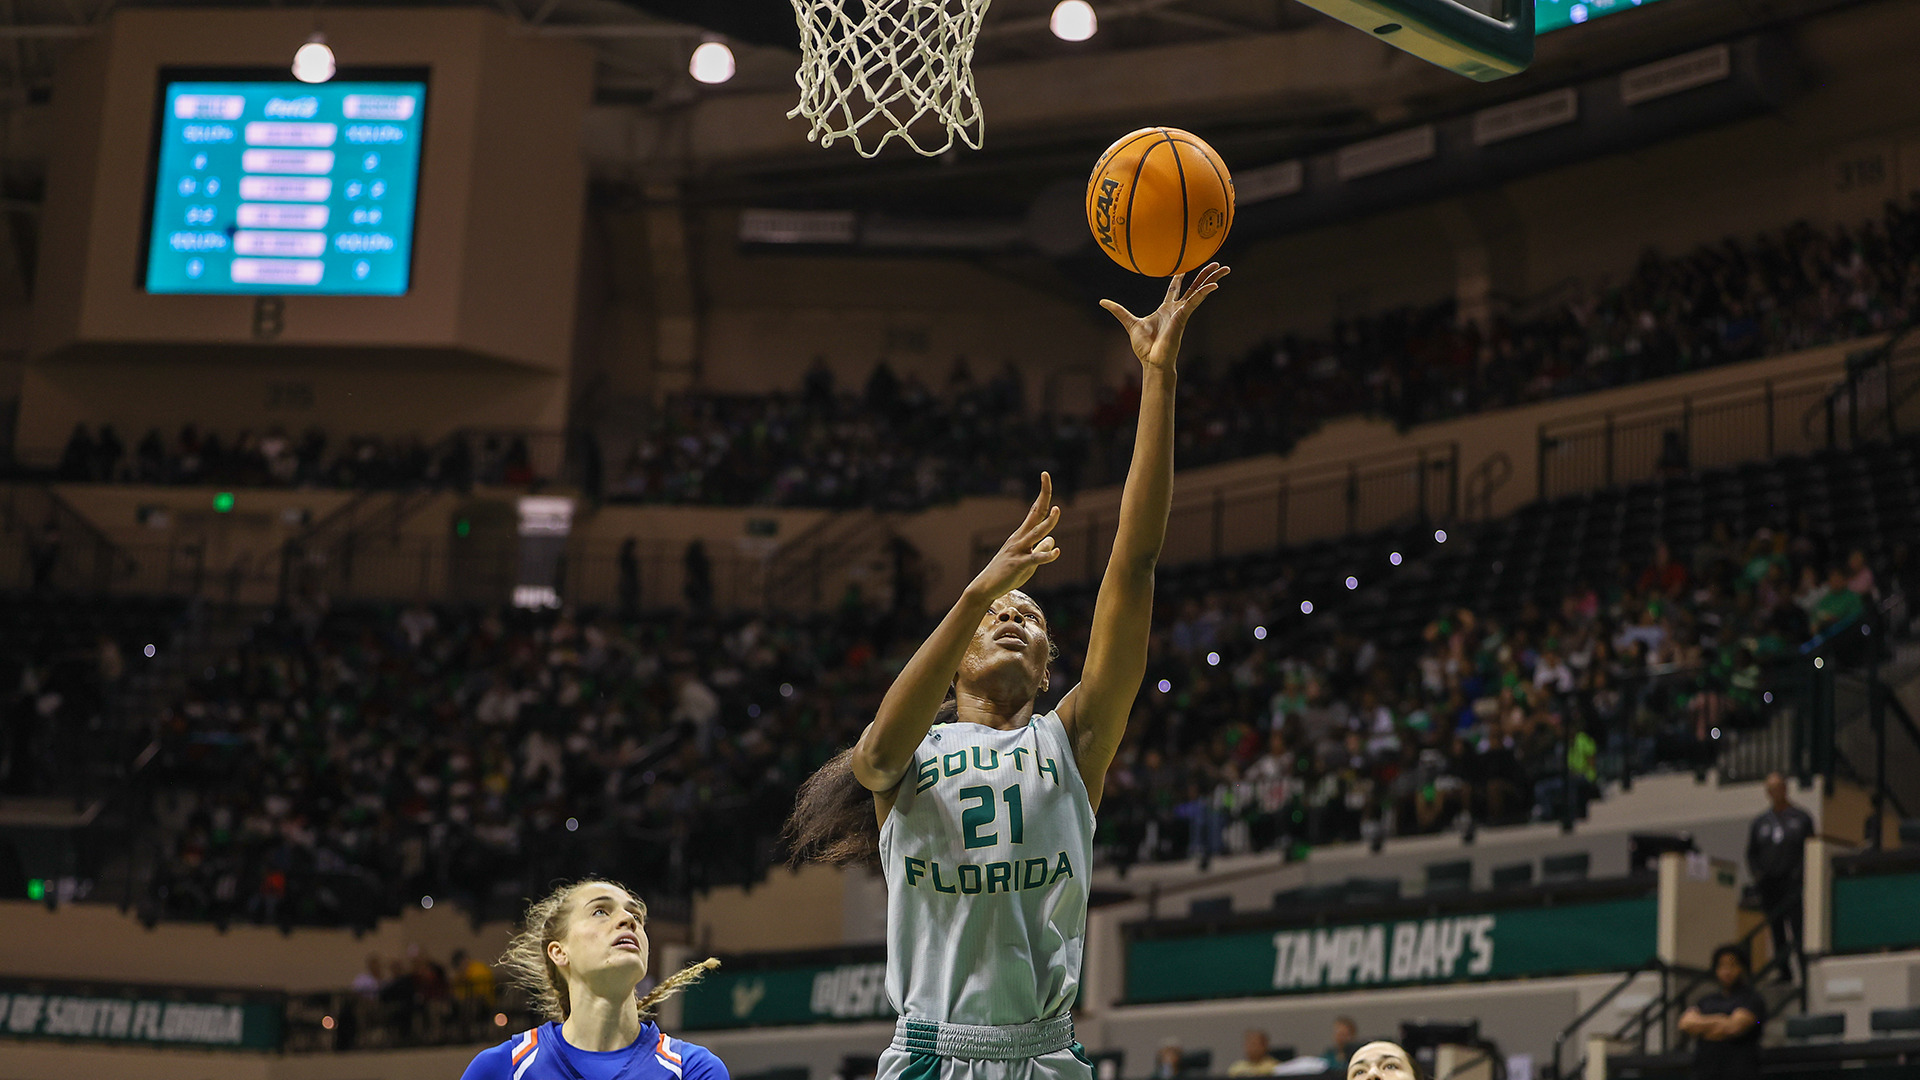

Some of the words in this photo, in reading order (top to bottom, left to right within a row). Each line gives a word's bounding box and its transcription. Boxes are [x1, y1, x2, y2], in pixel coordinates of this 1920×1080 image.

[1096, 177, 1120, 252] NCAA
[1115, 183, 1125, 202] BALL
[254, 297, 284, 336] B
[915, 745, 1060, 796] SOUTH
[959, 783, 1024, 850] 21
[904, 850, 1074, 896] FLORIDA
[1274, 926, 1385, 988] TAMPA
[1389, 915, 1495, 980] BAY'S
[8, 994, 44, 1033] OF
[43, 997, 131, 1037] SOUTH
[130, 1001, 244, 1044] FLORIDA
